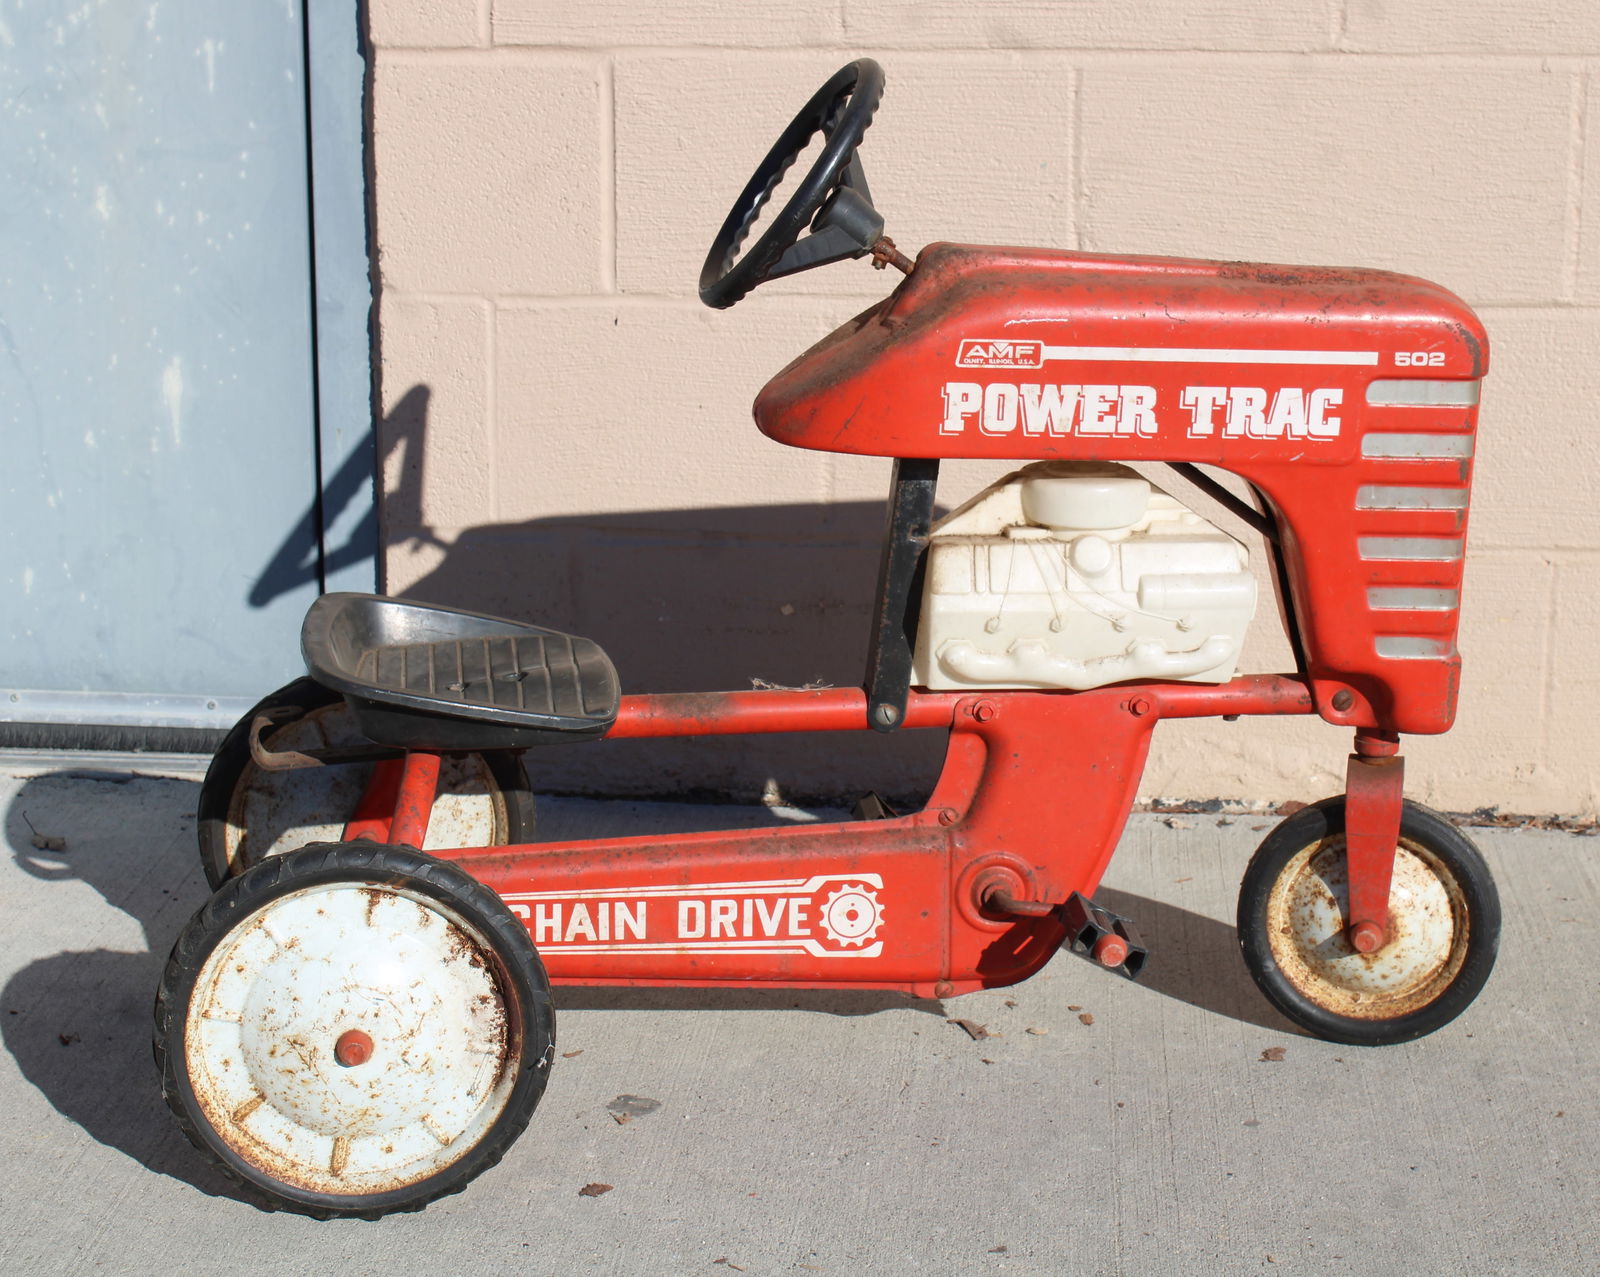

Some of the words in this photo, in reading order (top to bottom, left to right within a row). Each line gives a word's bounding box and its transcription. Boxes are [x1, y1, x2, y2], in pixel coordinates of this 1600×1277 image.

[966, 343, 1035, 358] AMF
[1394, 351, 1446, 367] 502
[939, 382, 1158, 438] POWER
[1180, 385, 1344, 441] TRAC
[677, 897, 812, 939] DRIVE
